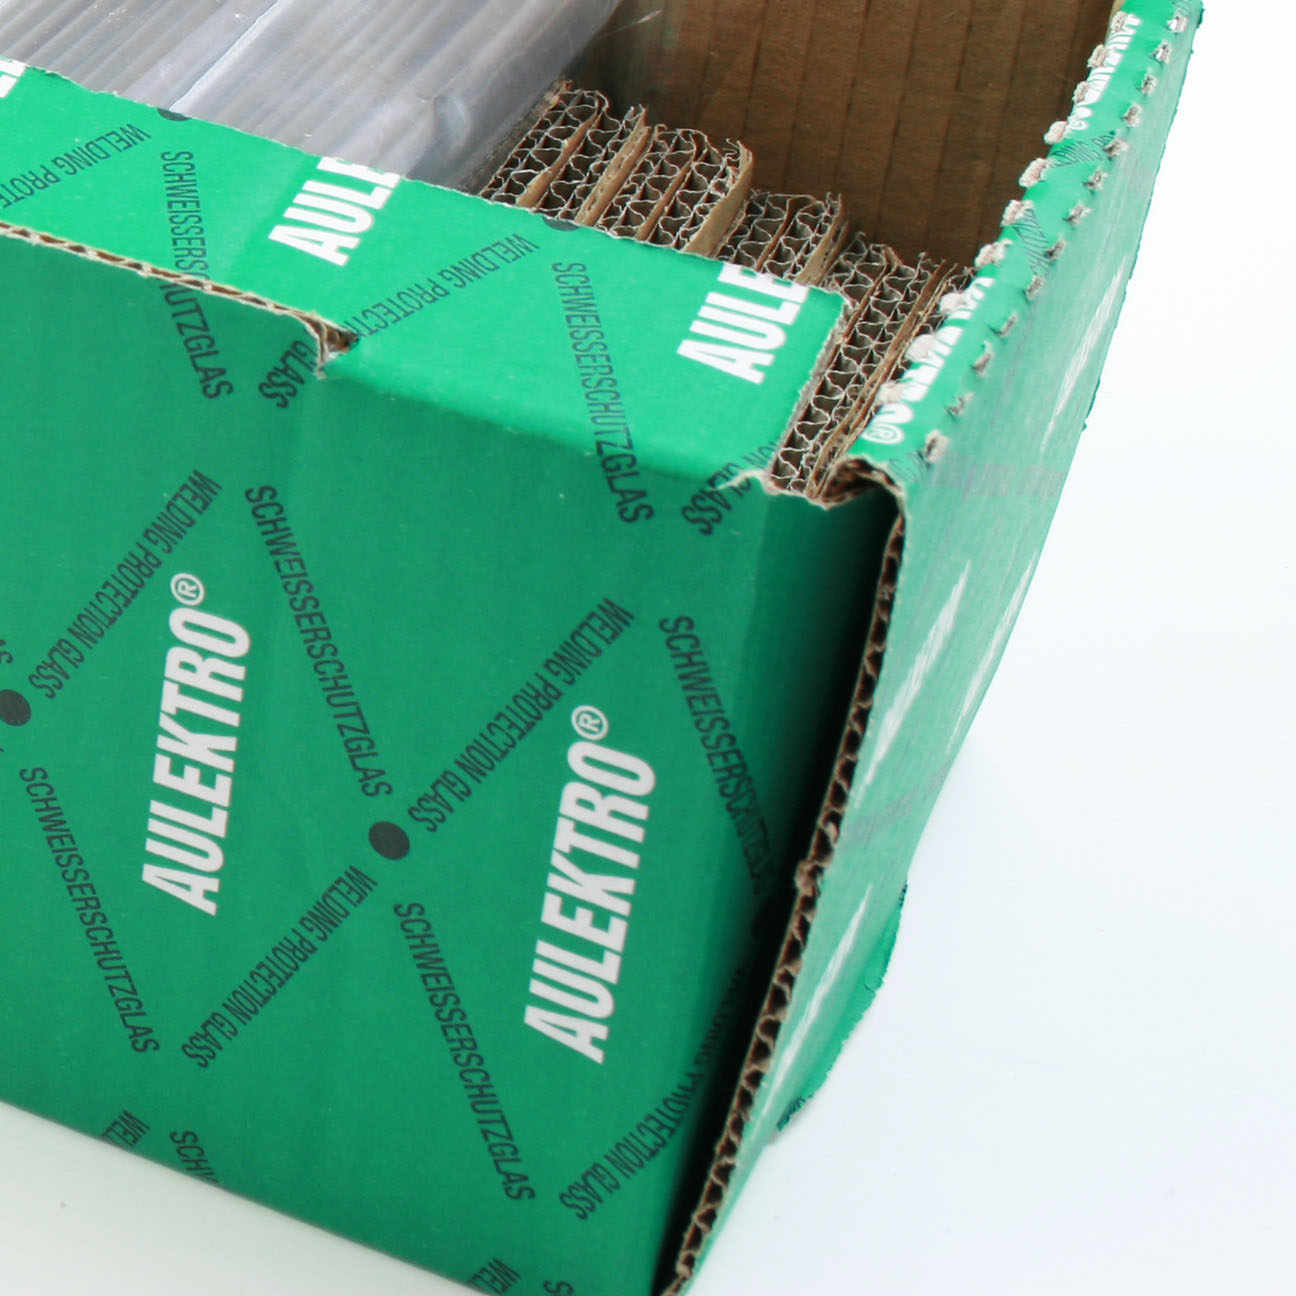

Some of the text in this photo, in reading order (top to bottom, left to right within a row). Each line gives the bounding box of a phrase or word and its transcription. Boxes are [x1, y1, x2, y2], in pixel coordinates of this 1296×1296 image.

[51, 124, 151, 175] WELDING
[438, 234, 539, 288] WELDING
[551, 262, 656, 523] SCHWEISSERSCHUTZGLAS
[28, 470, 222, 699] WELDING PROTECTION GLASS
[244, 485, 394, 797] SCHWEISSERSCHUTZGLAS
[407, 597, 635, 833] WELDING PROTECTION GLASS
[18, 767, 161, 1053] SCHWEISSERSCHUTZGLAS
[221, 928, 319, 1026] PROTECTION
[298, 865, 378, 942] WELDING
[181, 1012, 239, 1069] GLASS
[392, 902, 537, 1200] SCHWEISSERSCHUTZGLAS
[559, 1162, 621, 1220] GLASS
